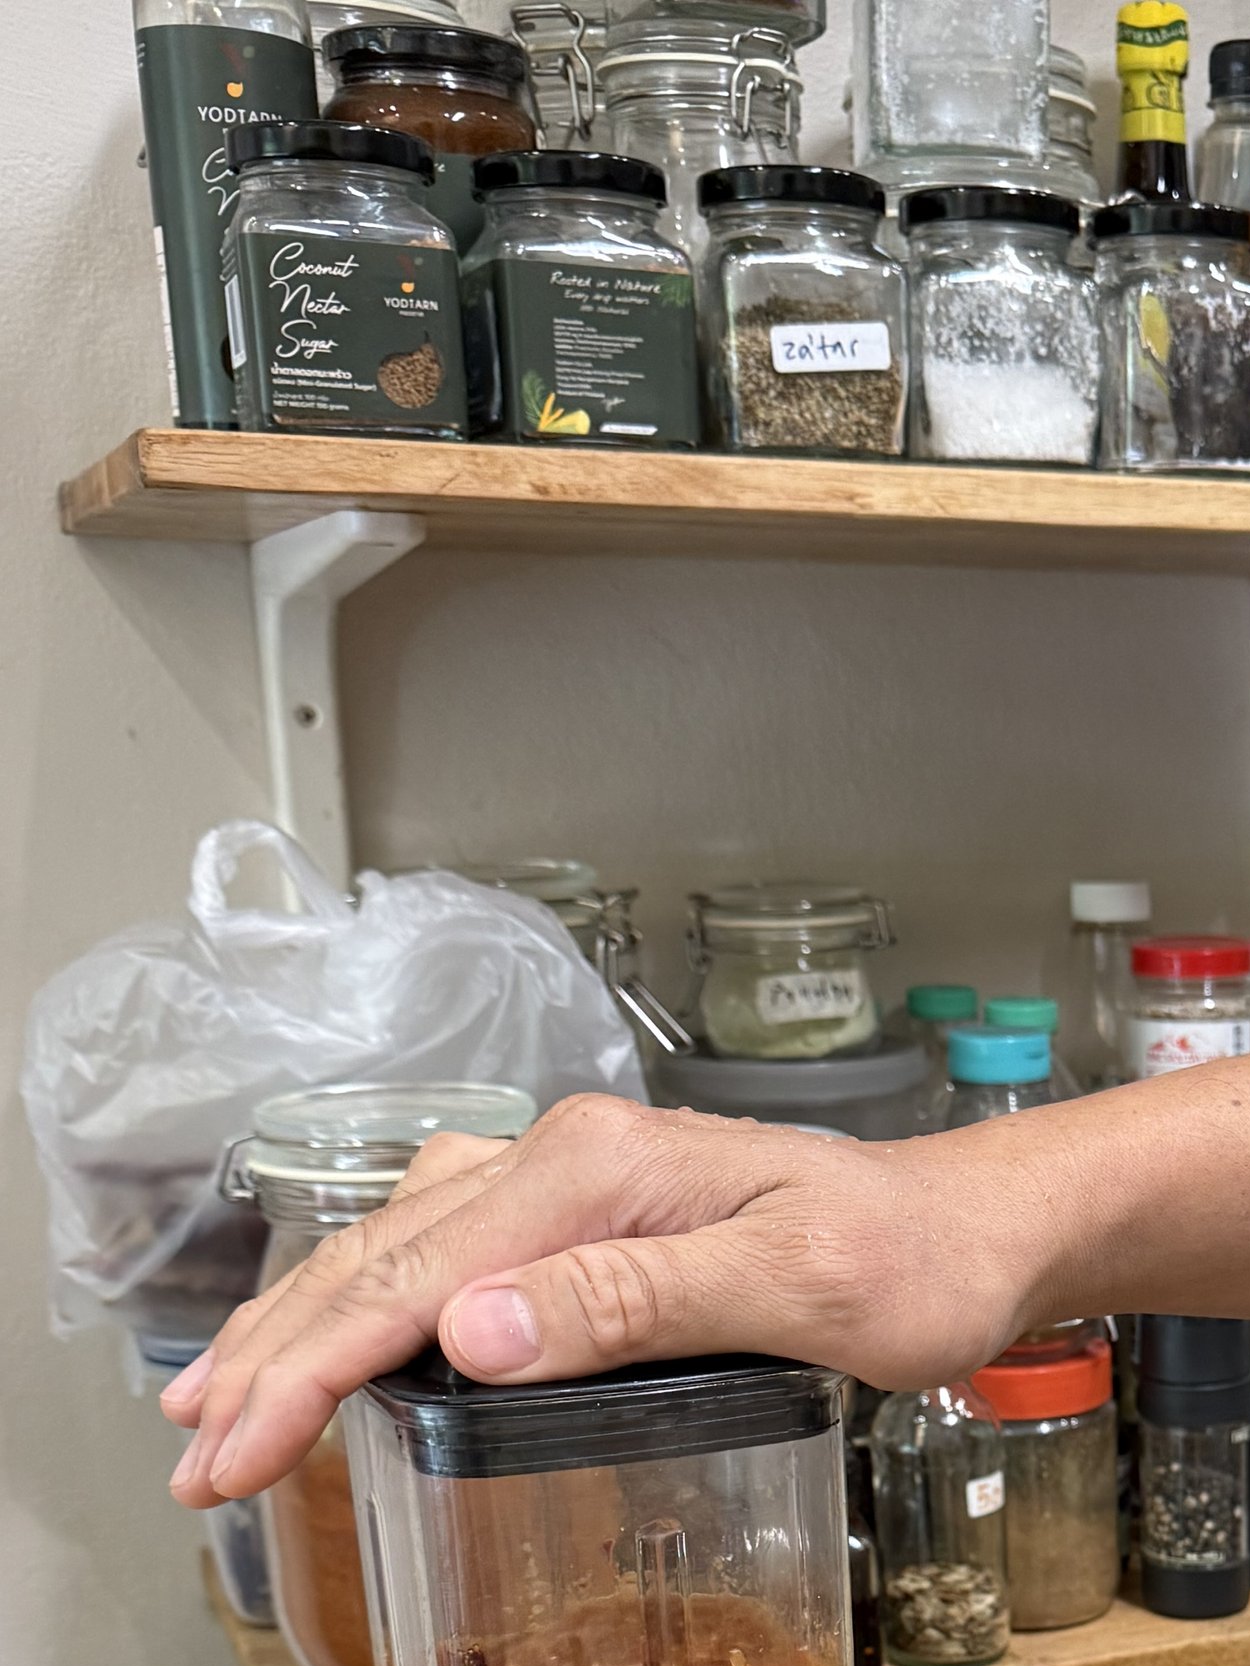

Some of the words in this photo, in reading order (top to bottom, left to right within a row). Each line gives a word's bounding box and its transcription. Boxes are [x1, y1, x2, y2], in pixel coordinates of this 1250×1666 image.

[270, 242, 360, 281] Coconut
[269, 280, 351, 319] Nectar
[550, 270, 592, 288] Rooted
[596, 279, 609, 289] in
[614, 279, 661, 294] Nature
[384, 296, 439, 312] YODTARN
[276, 319, 339, 359] Sugar
